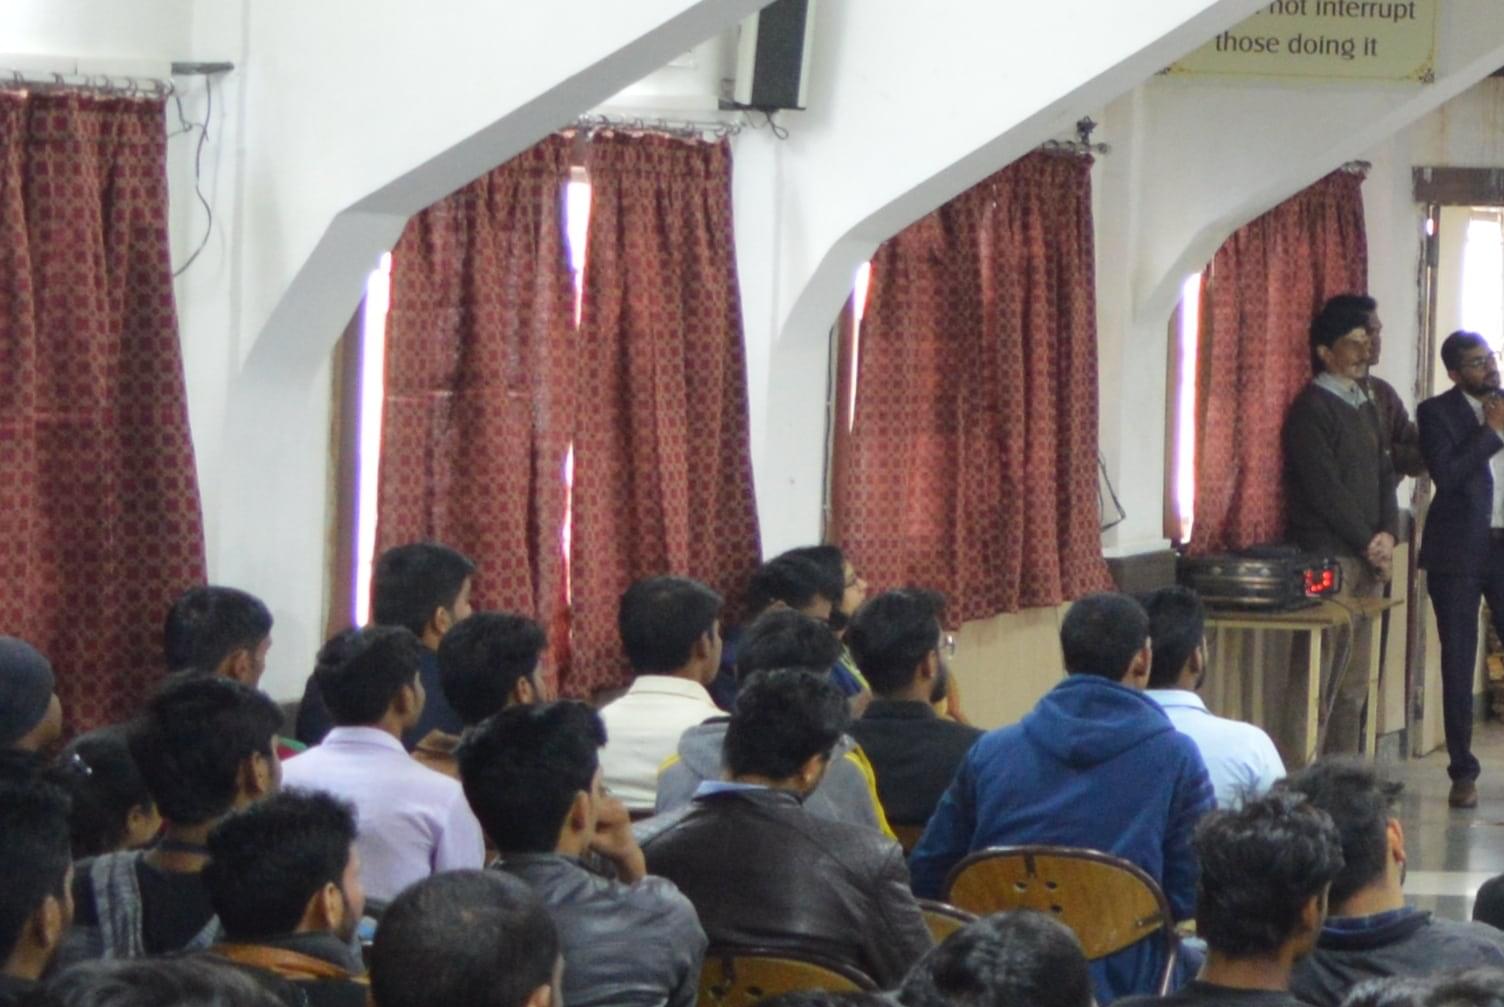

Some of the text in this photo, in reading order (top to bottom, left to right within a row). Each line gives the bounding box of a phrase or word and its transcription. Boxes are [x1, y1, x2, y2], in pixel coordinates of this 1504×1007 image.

[1316, 0, 1416, 23] interrupt
[1216, 31, 1378, 60] those doing it
